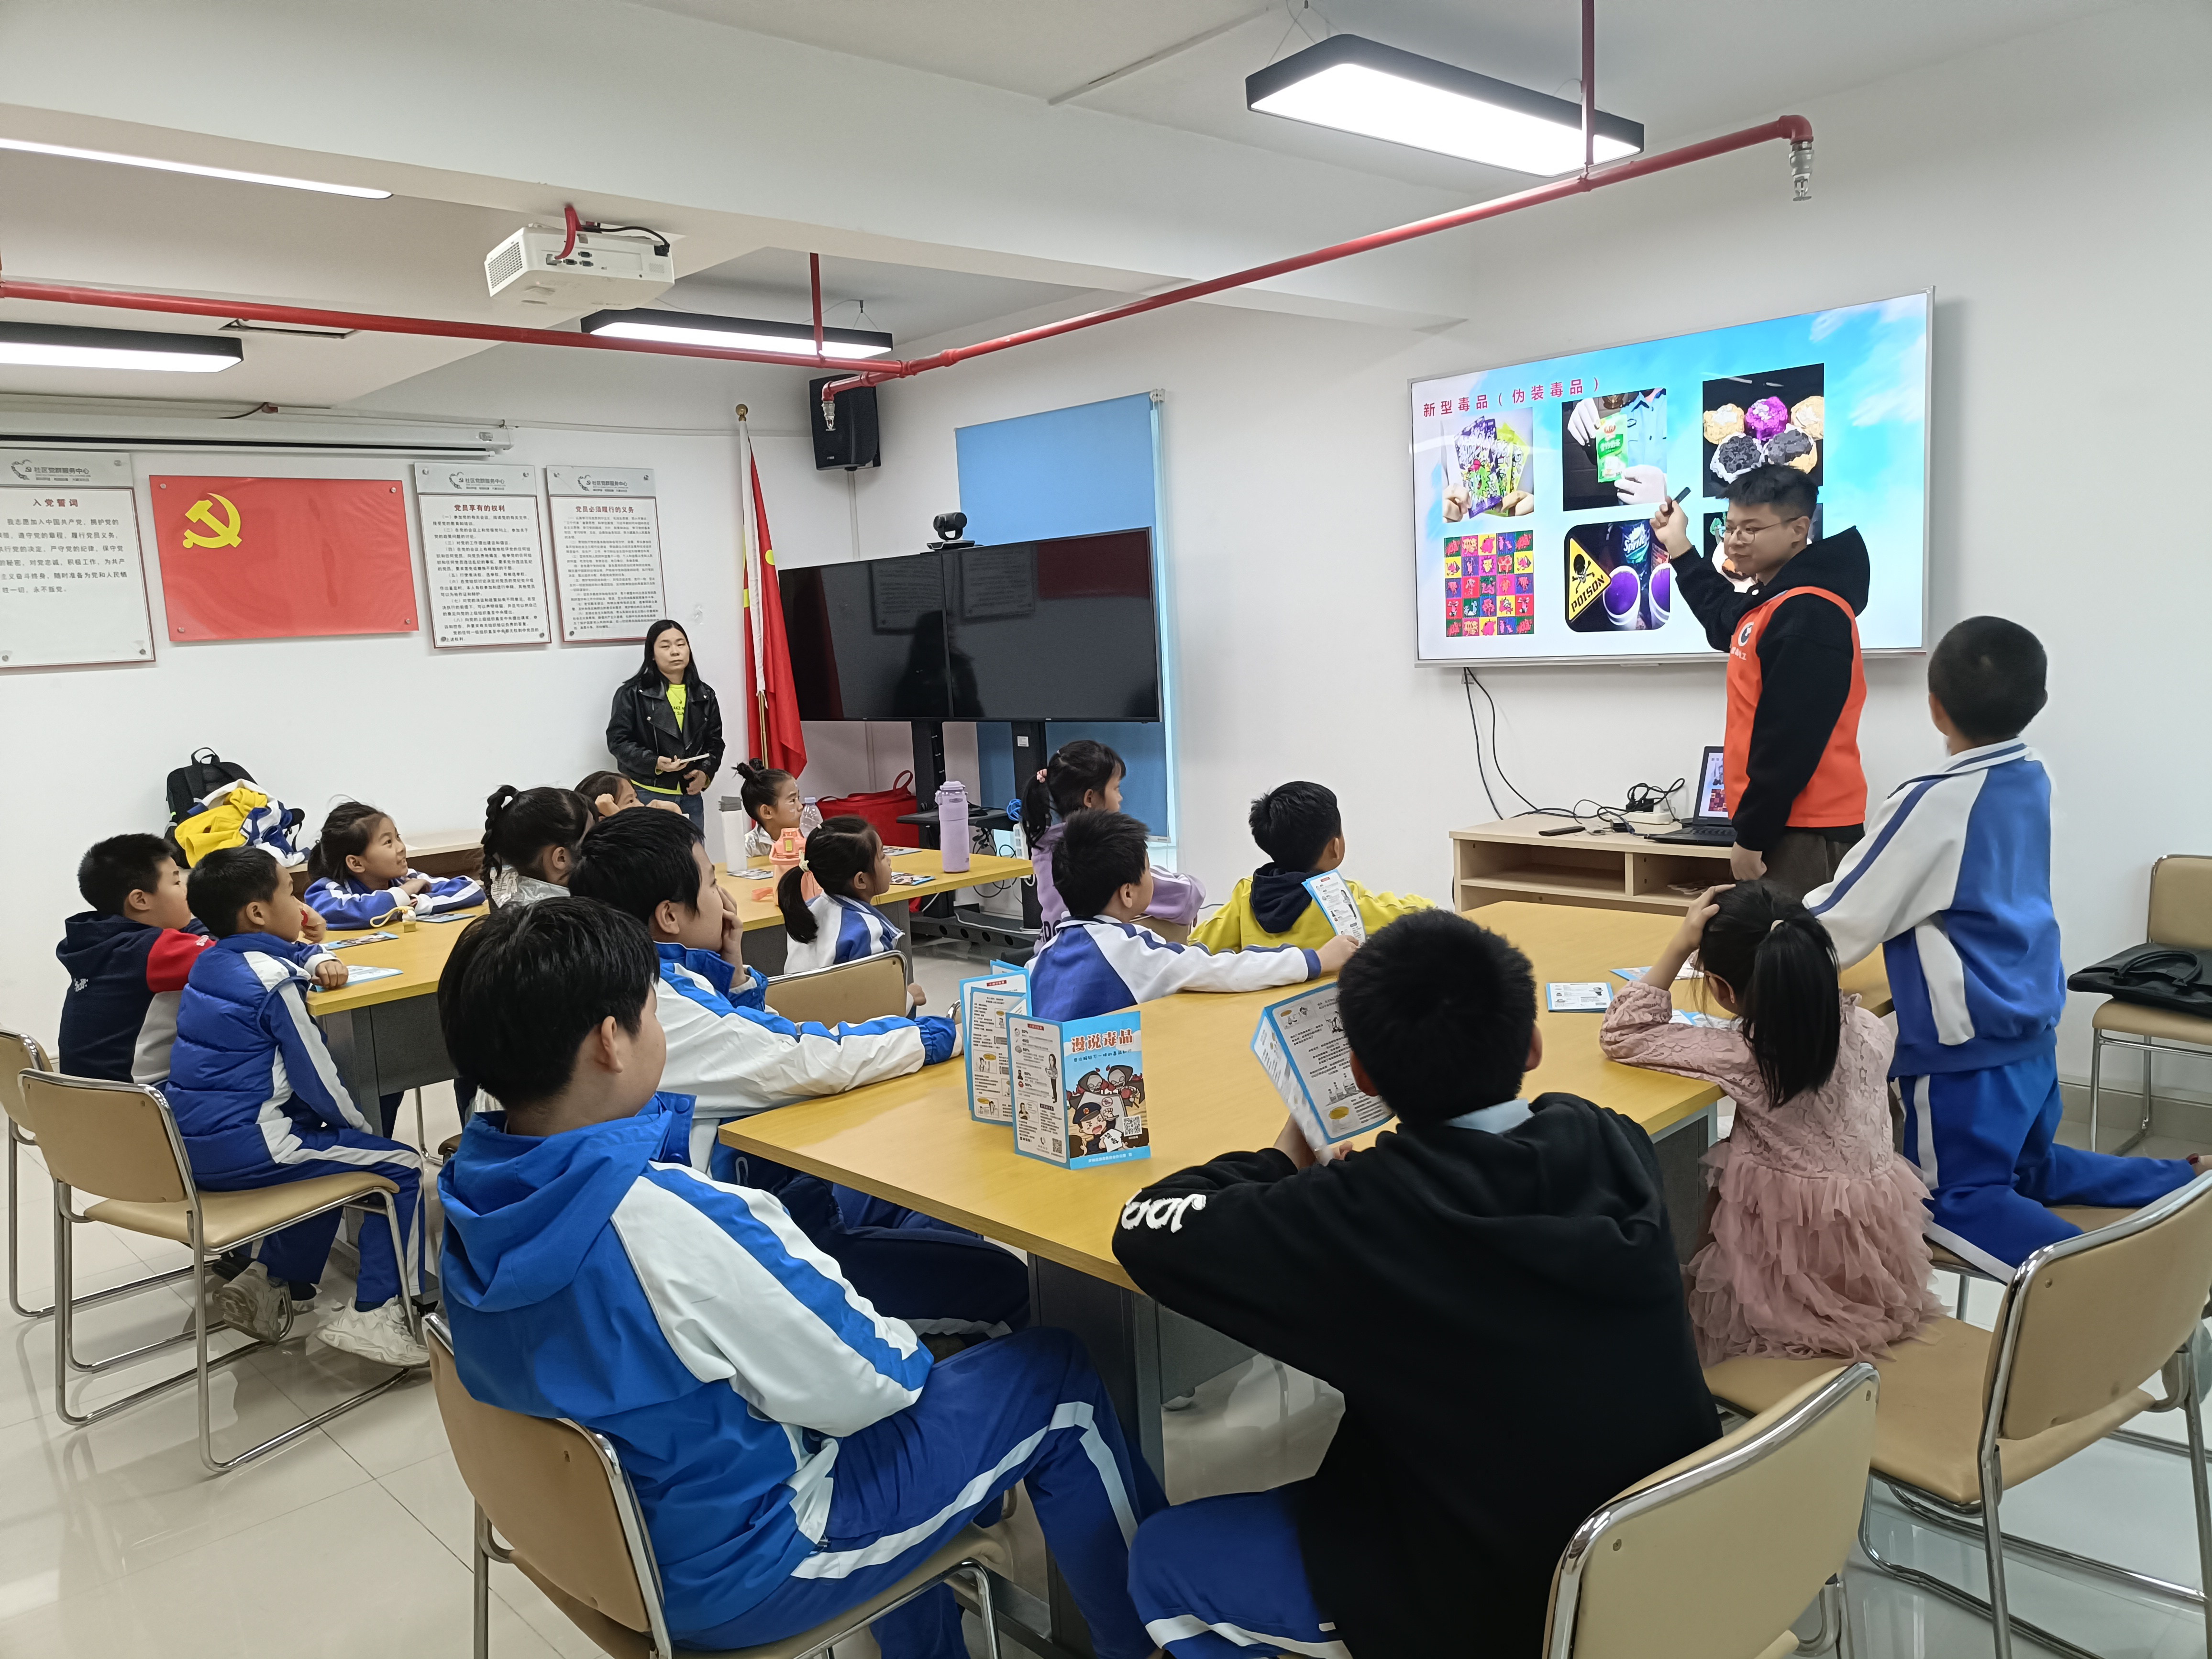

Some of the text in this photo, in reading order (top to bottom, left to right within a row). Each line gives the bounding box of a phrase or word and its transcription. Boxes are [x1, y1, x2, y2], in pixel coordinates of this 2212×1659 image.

[33, 498, 78, 507] 入党誓词
[1623, 533, 1647, 553] Sprite
[1571, 574, 1605, 613] POISON
[1071, 1029, 1134, 1053] 漫说毒品
